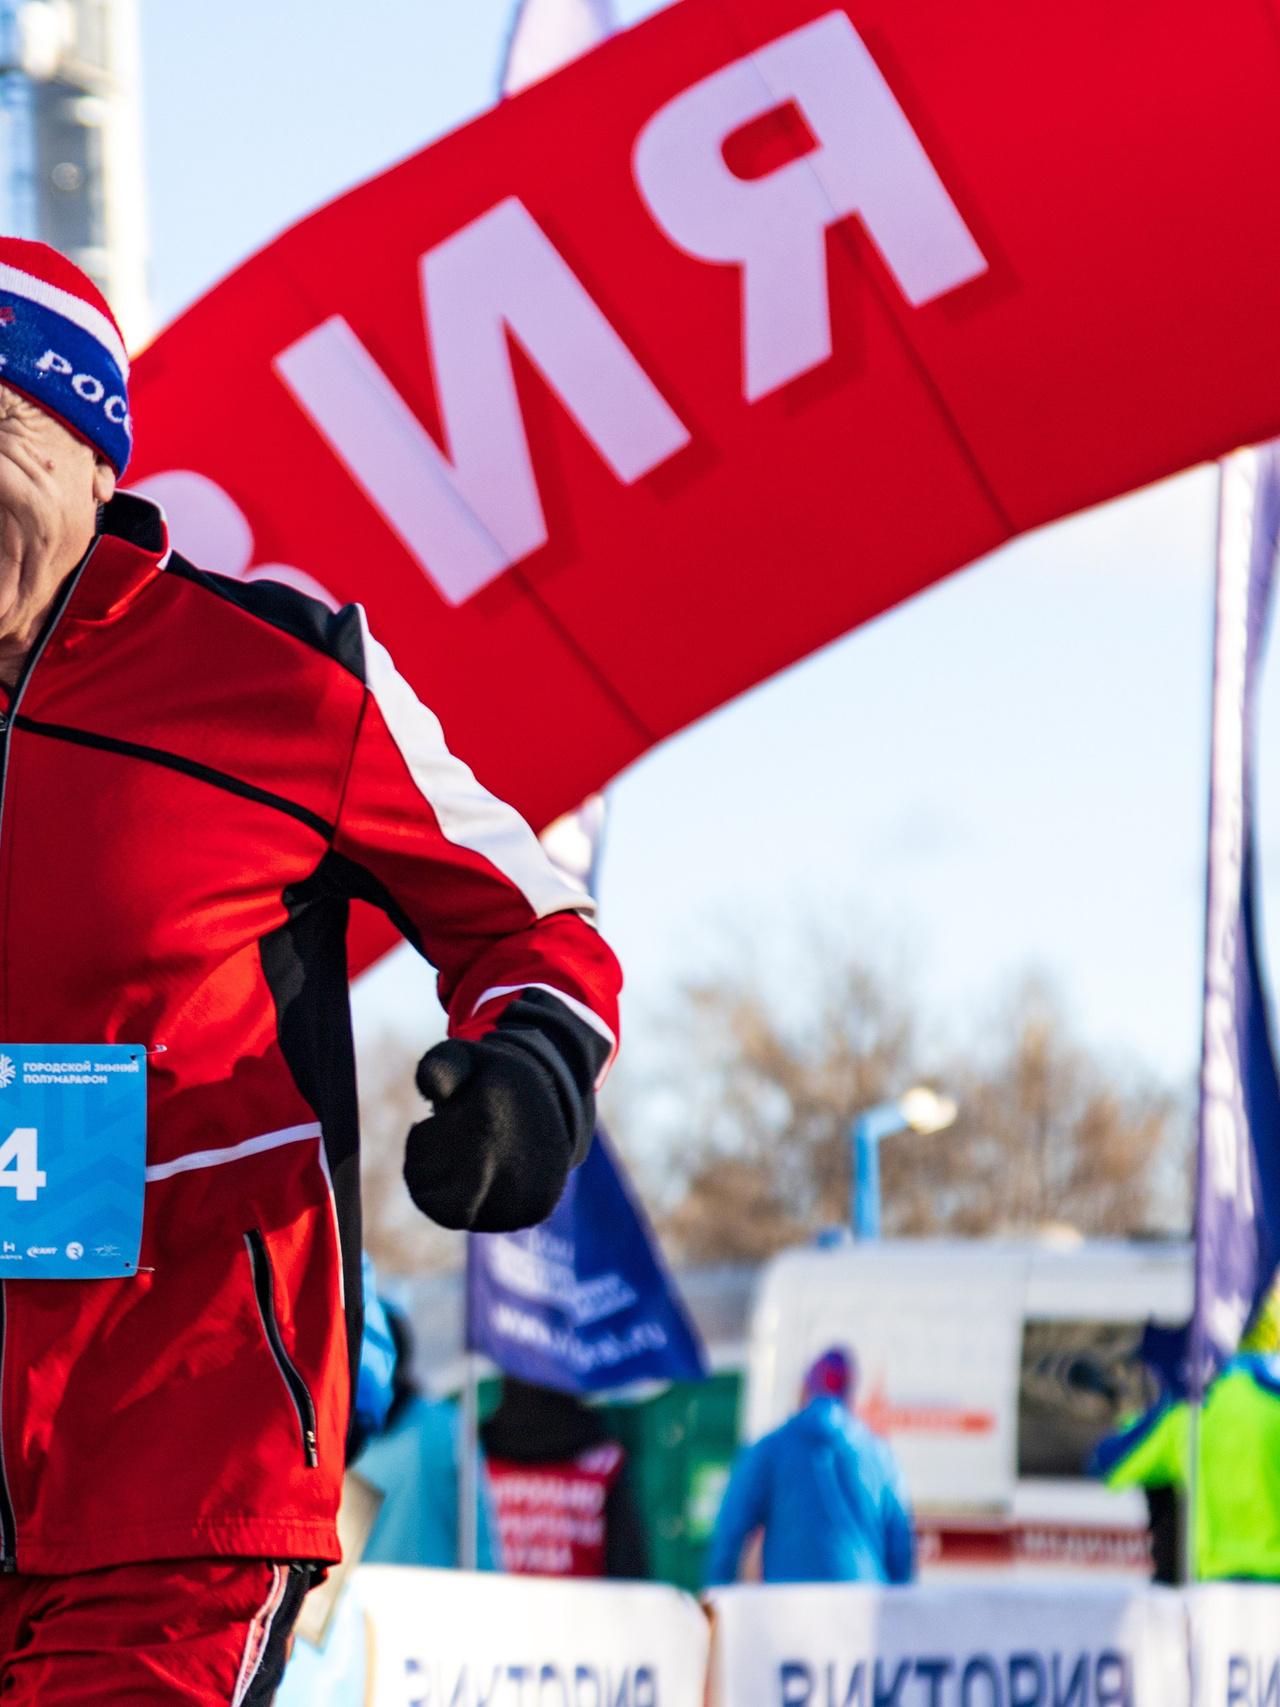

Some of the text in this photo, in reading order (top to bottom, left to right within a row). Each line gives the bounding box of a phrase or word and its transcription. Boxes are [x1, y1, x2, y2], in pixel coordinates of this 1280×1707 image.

[35, 348, 131, 439] РОС
[23, 1060, 139, 1073] ГОРОДСКОЙ ЗИМНИЙ
[23, 1074, 108, 1084] ПОЛУМАРАФОН
[779, 1648, 1132, 1707] ВИКТОРИЯ
